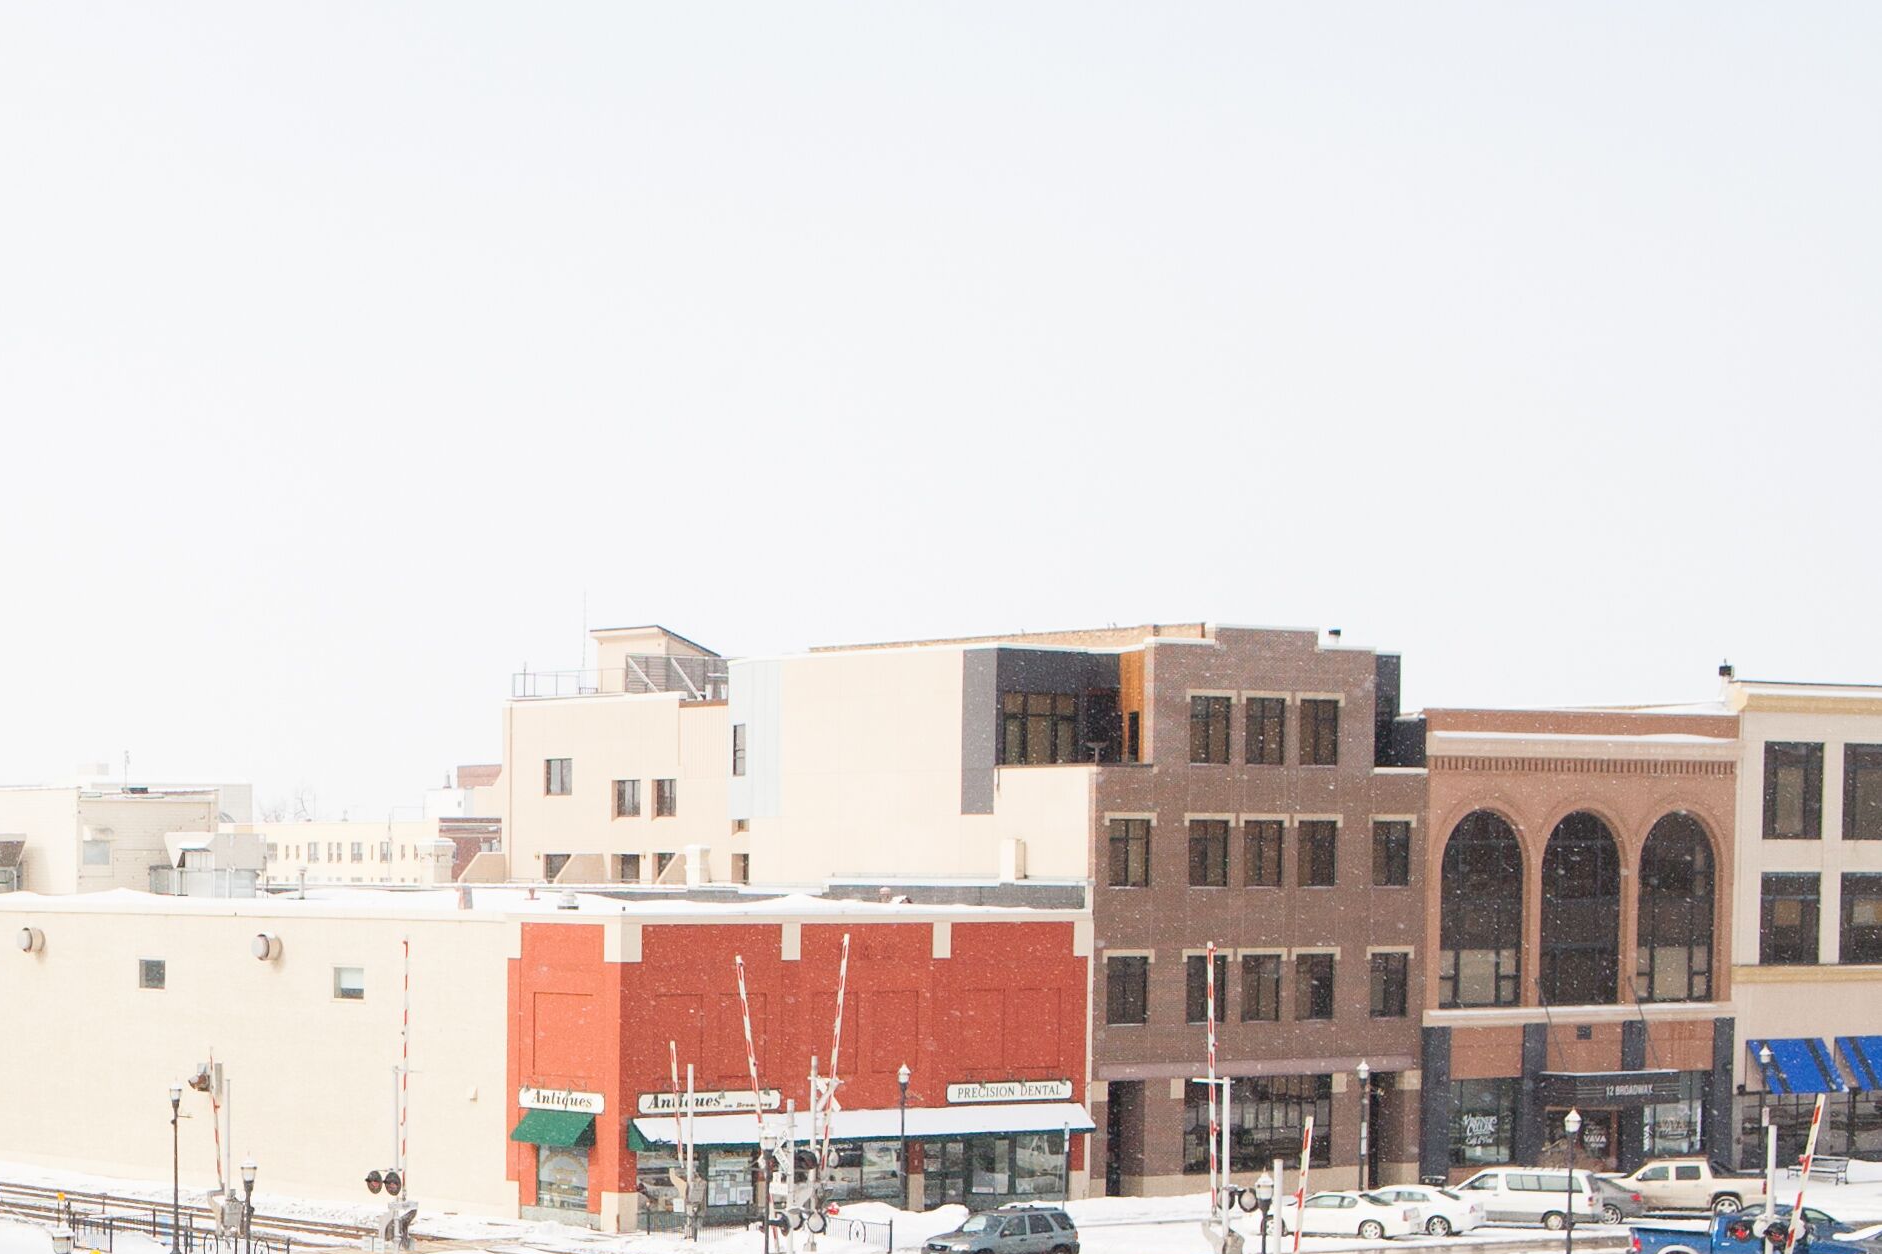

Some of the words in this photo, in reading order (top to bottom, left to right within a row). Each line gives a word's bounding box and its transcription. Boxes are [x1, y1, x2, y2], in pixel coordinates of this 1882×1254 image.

[957, 1087, 1015, 1099] PRECISION
[1020, 1084, 1062, 1097] DENTAL
[1606, 1084, 1614, 1097] 12
[1615, 1084, 1654, 1097] BROADWAY
[531, 1090, 593, 1109] Antiques
[647, 1093, 721, 1110] Antiues
